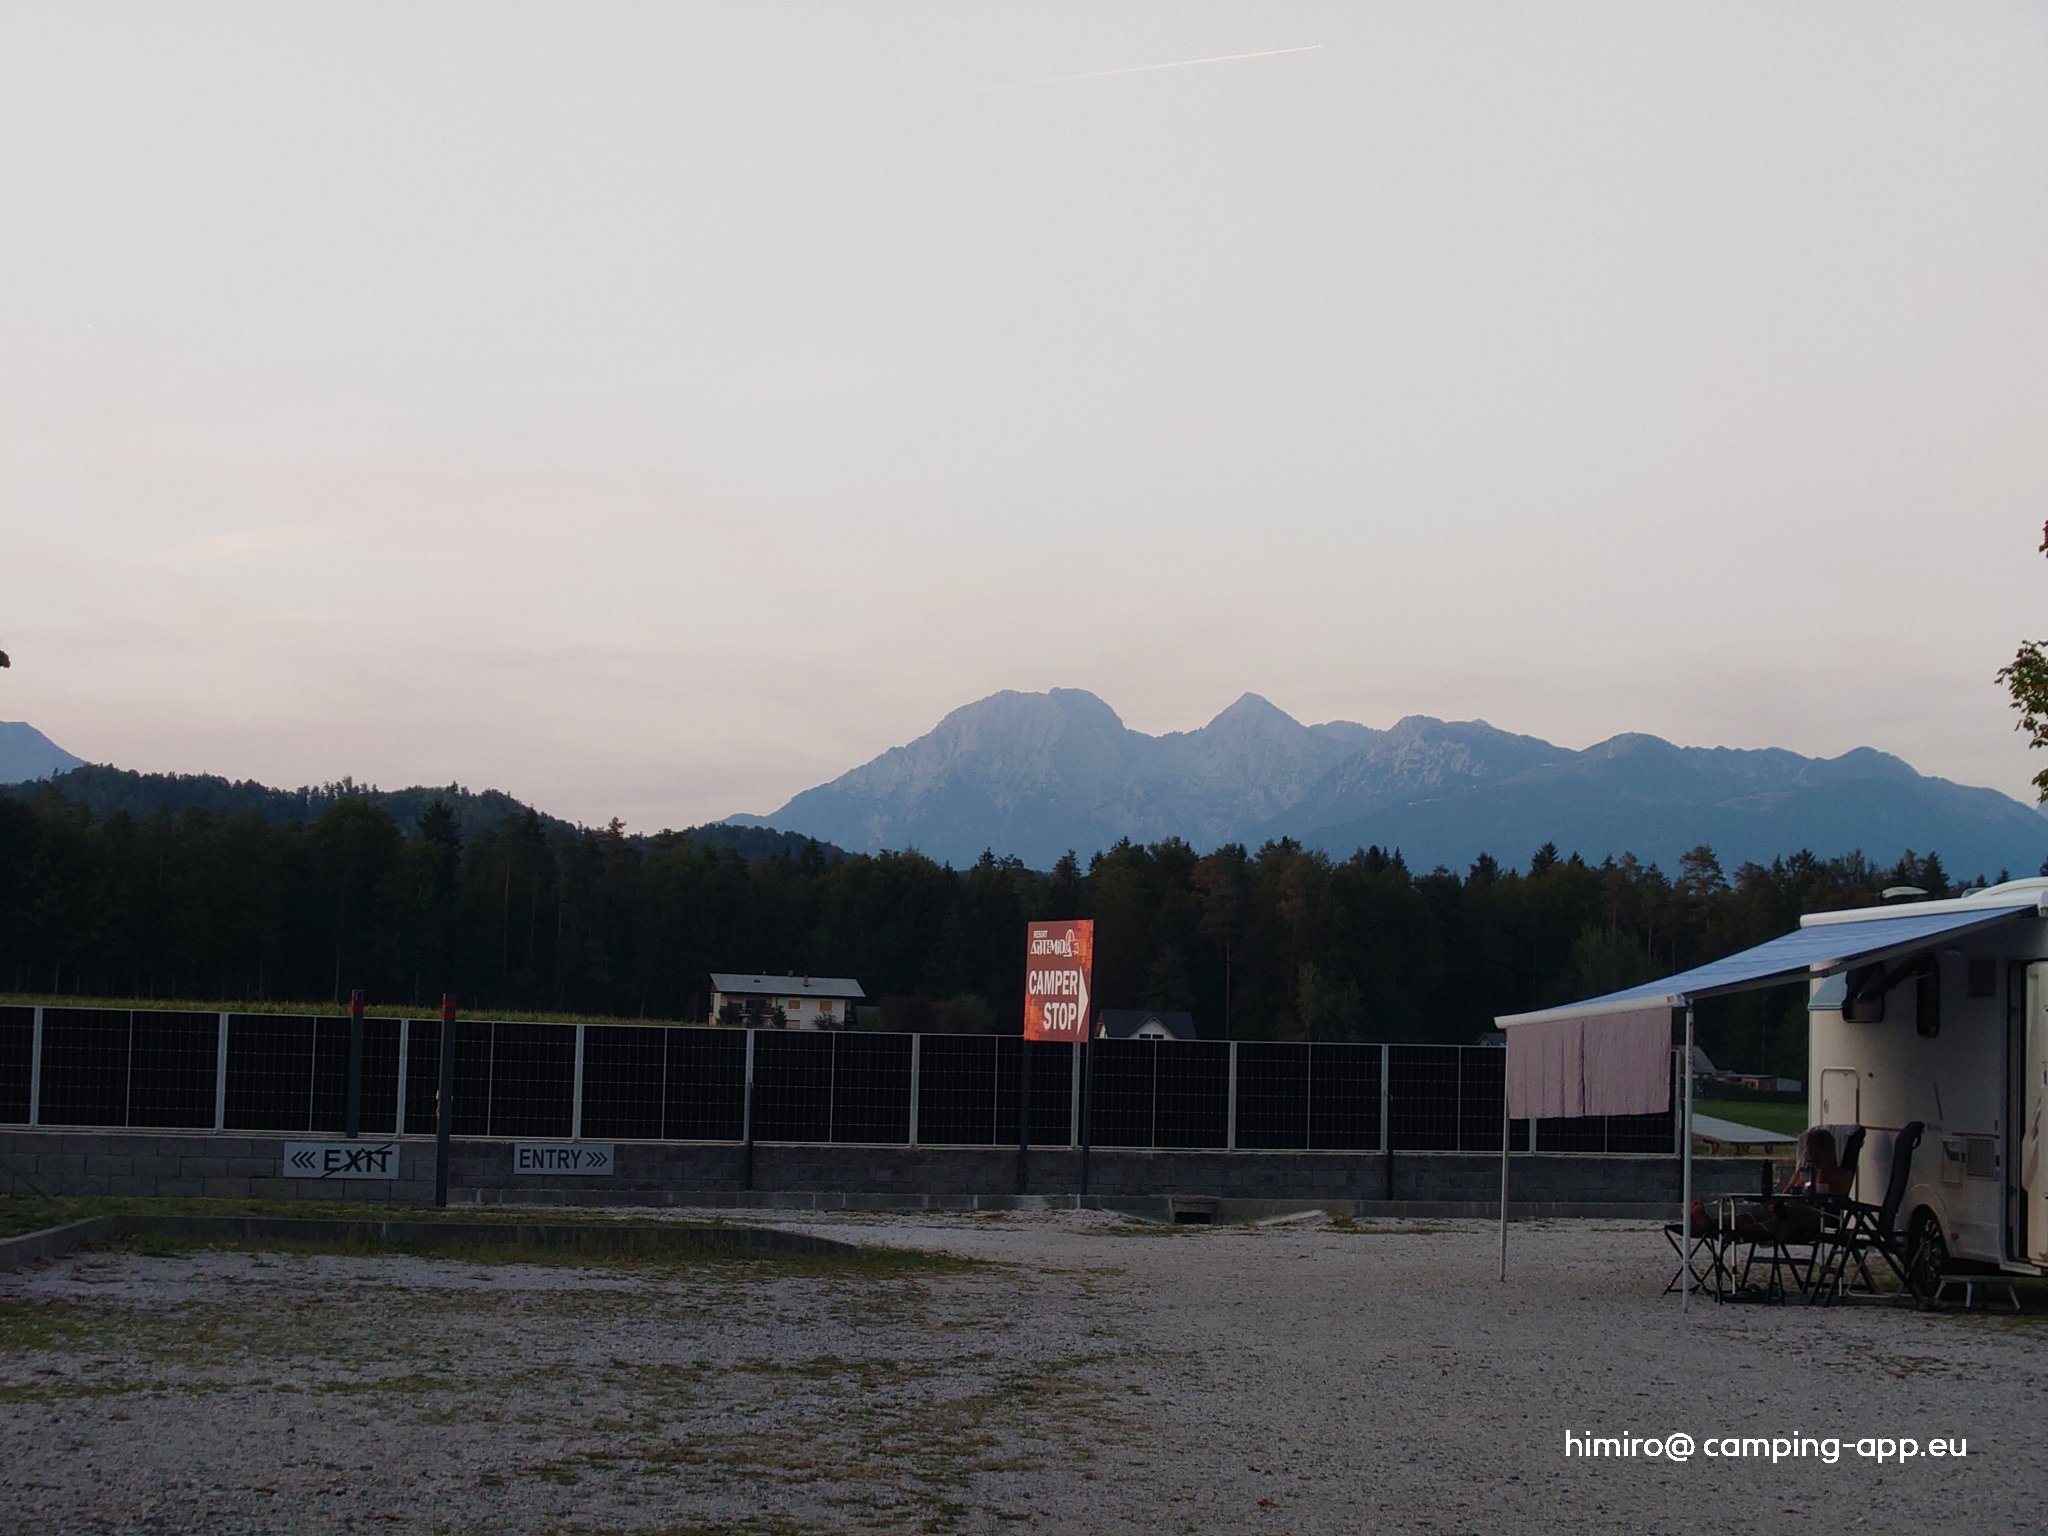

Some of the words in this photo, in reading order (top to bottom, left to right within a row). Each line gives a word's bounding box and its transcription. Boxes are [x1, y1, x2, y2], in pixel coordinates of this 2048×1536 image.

[1028, 970, 1078, 995] CAMPER
[1043, 1002, 1077, 1030] STOP
[324, 1149, 393, 1173] EXIT
[519, 1148, 582, 1169] ENTRY
